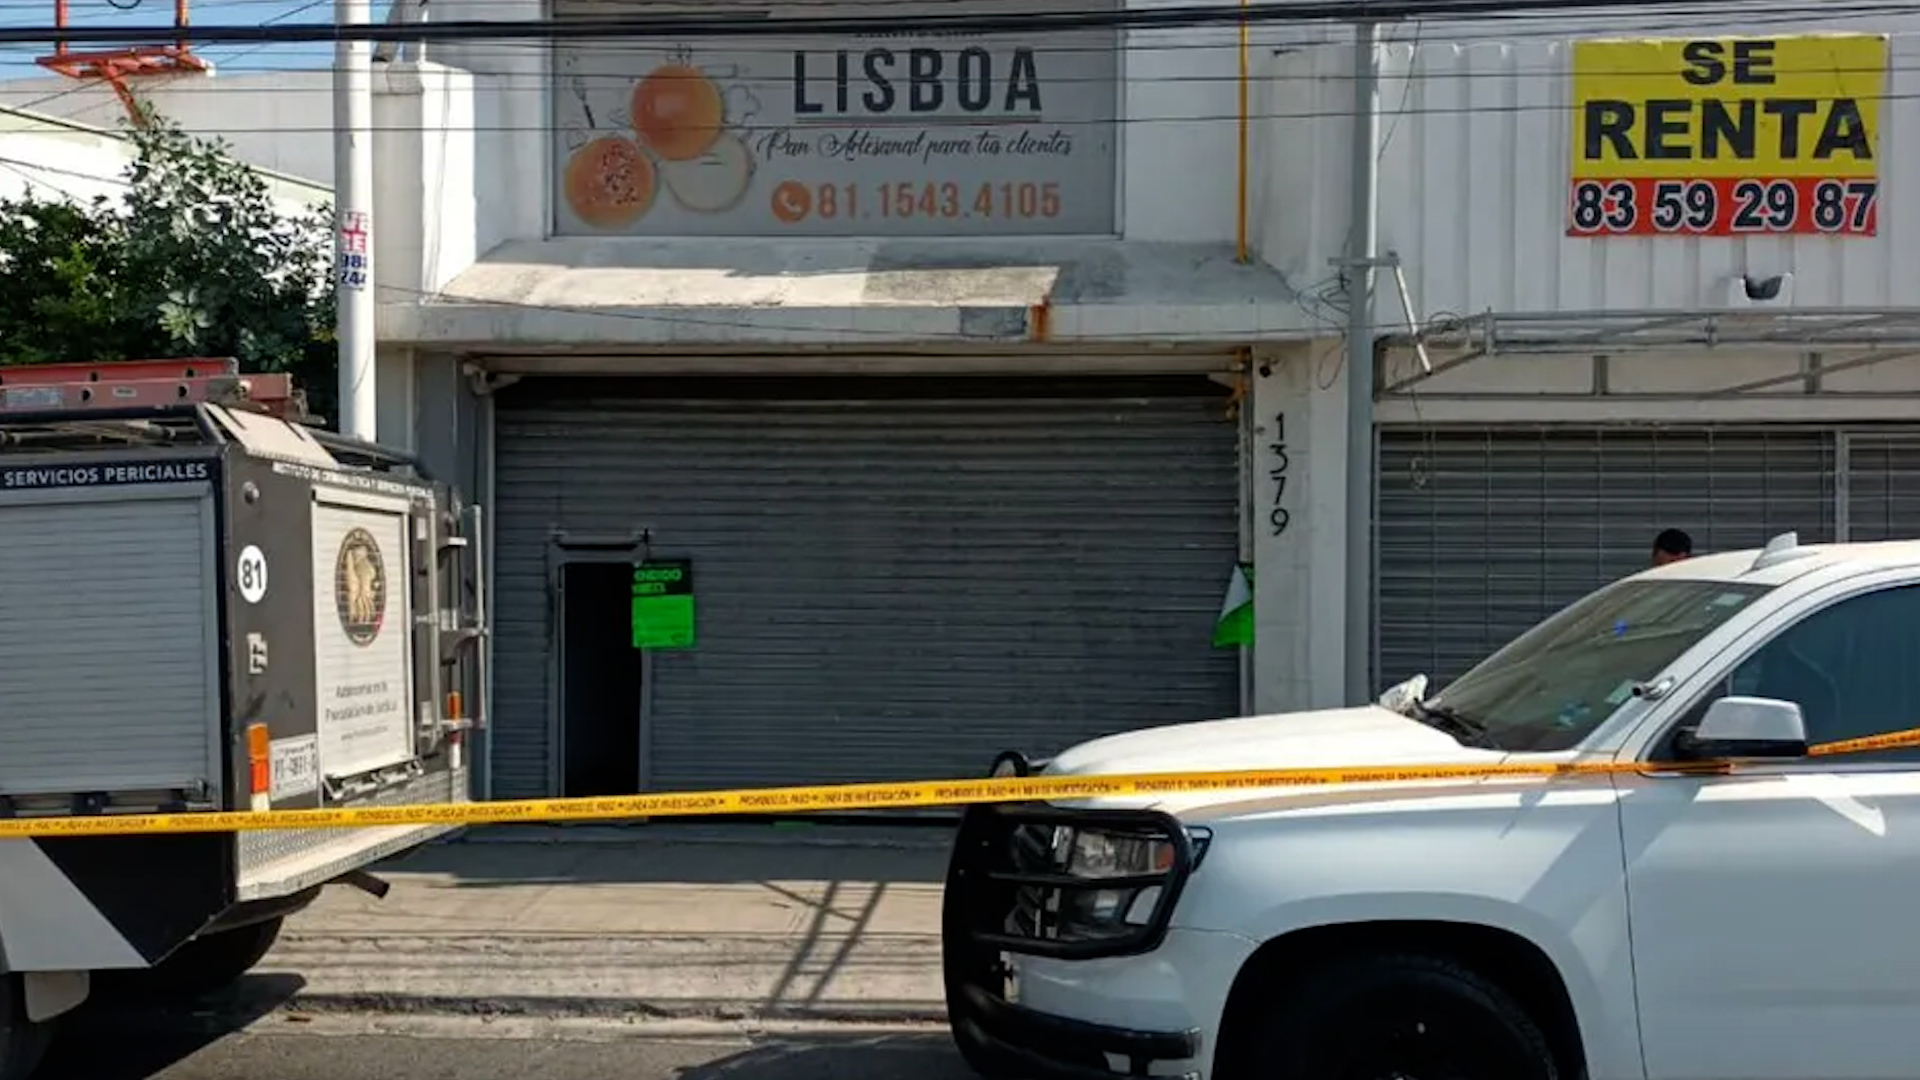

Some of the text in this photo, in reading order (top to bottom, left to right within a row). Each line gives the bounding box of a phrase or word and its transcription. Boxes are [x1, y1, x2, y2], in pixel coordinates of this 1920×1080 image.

[794, 47, 1042, 114] LISBOA
[1681, 40, 1776, 86] SE
[757, 128, 1073, 164] Pan Artesanal para tus clientes
[1584, 98, 1873, 160] RENTA
[819, 182, 1060, 219] 81.1543.4105
[1573, 179, 1878, 232] 83 59 29 87
[4, 463, 207, 487] SERVICIOS PERICIALES
[1269, 412, 1290, 537] 1379
[242, 559, 262, 590] 81
